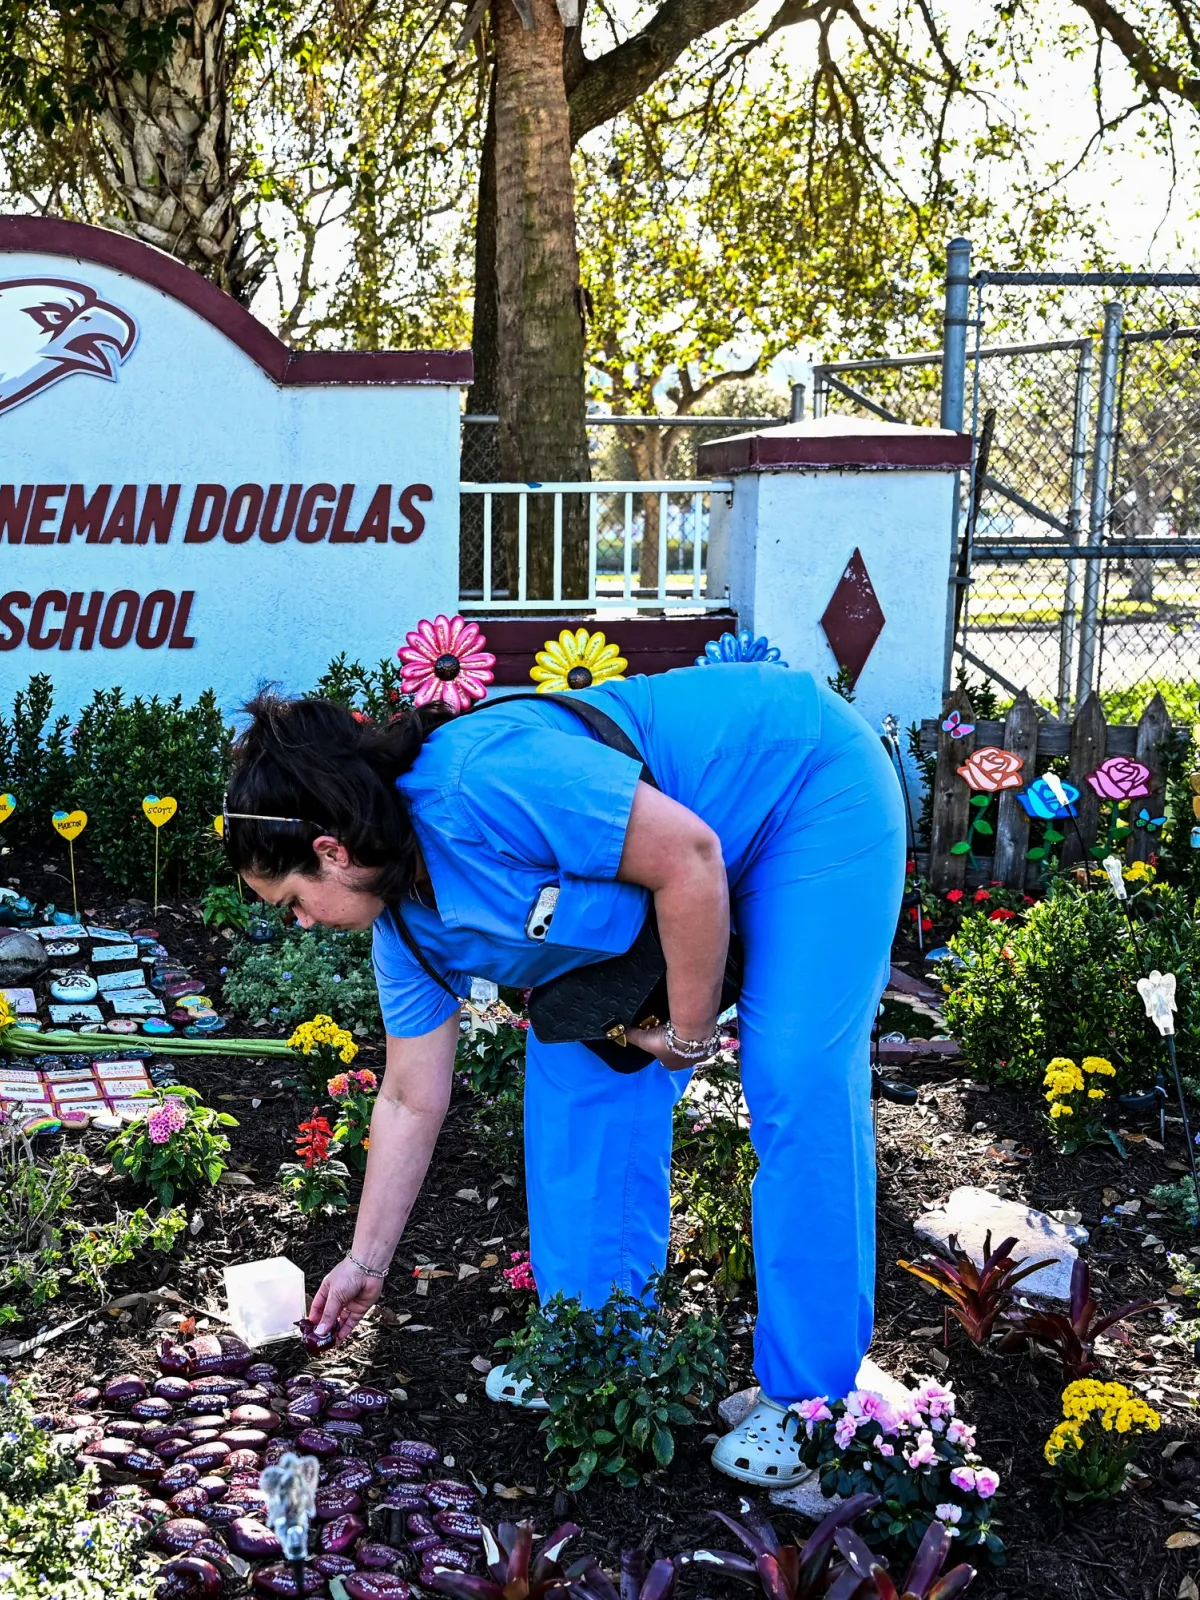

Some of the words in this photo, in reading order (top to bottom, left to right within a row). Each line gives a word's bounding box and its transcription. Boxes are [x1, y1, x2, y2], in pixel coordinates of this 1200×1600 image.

[184, 482, 434, 544] DOUGLAS
[146, 806, 173, 815] SCOTT
[57, 819, 83, 830] MARTIN
[199, 1357, 223, 1366] SPREAD
[349, 1393, 375, 1406] MSD
[340, 1472, 364, 1485] SPREAD
[345, 1479, 360, 1489] LOVE
[174, 1541, 194, 1549] LOVE
[382, 1587, 403, 1595] LOVE
